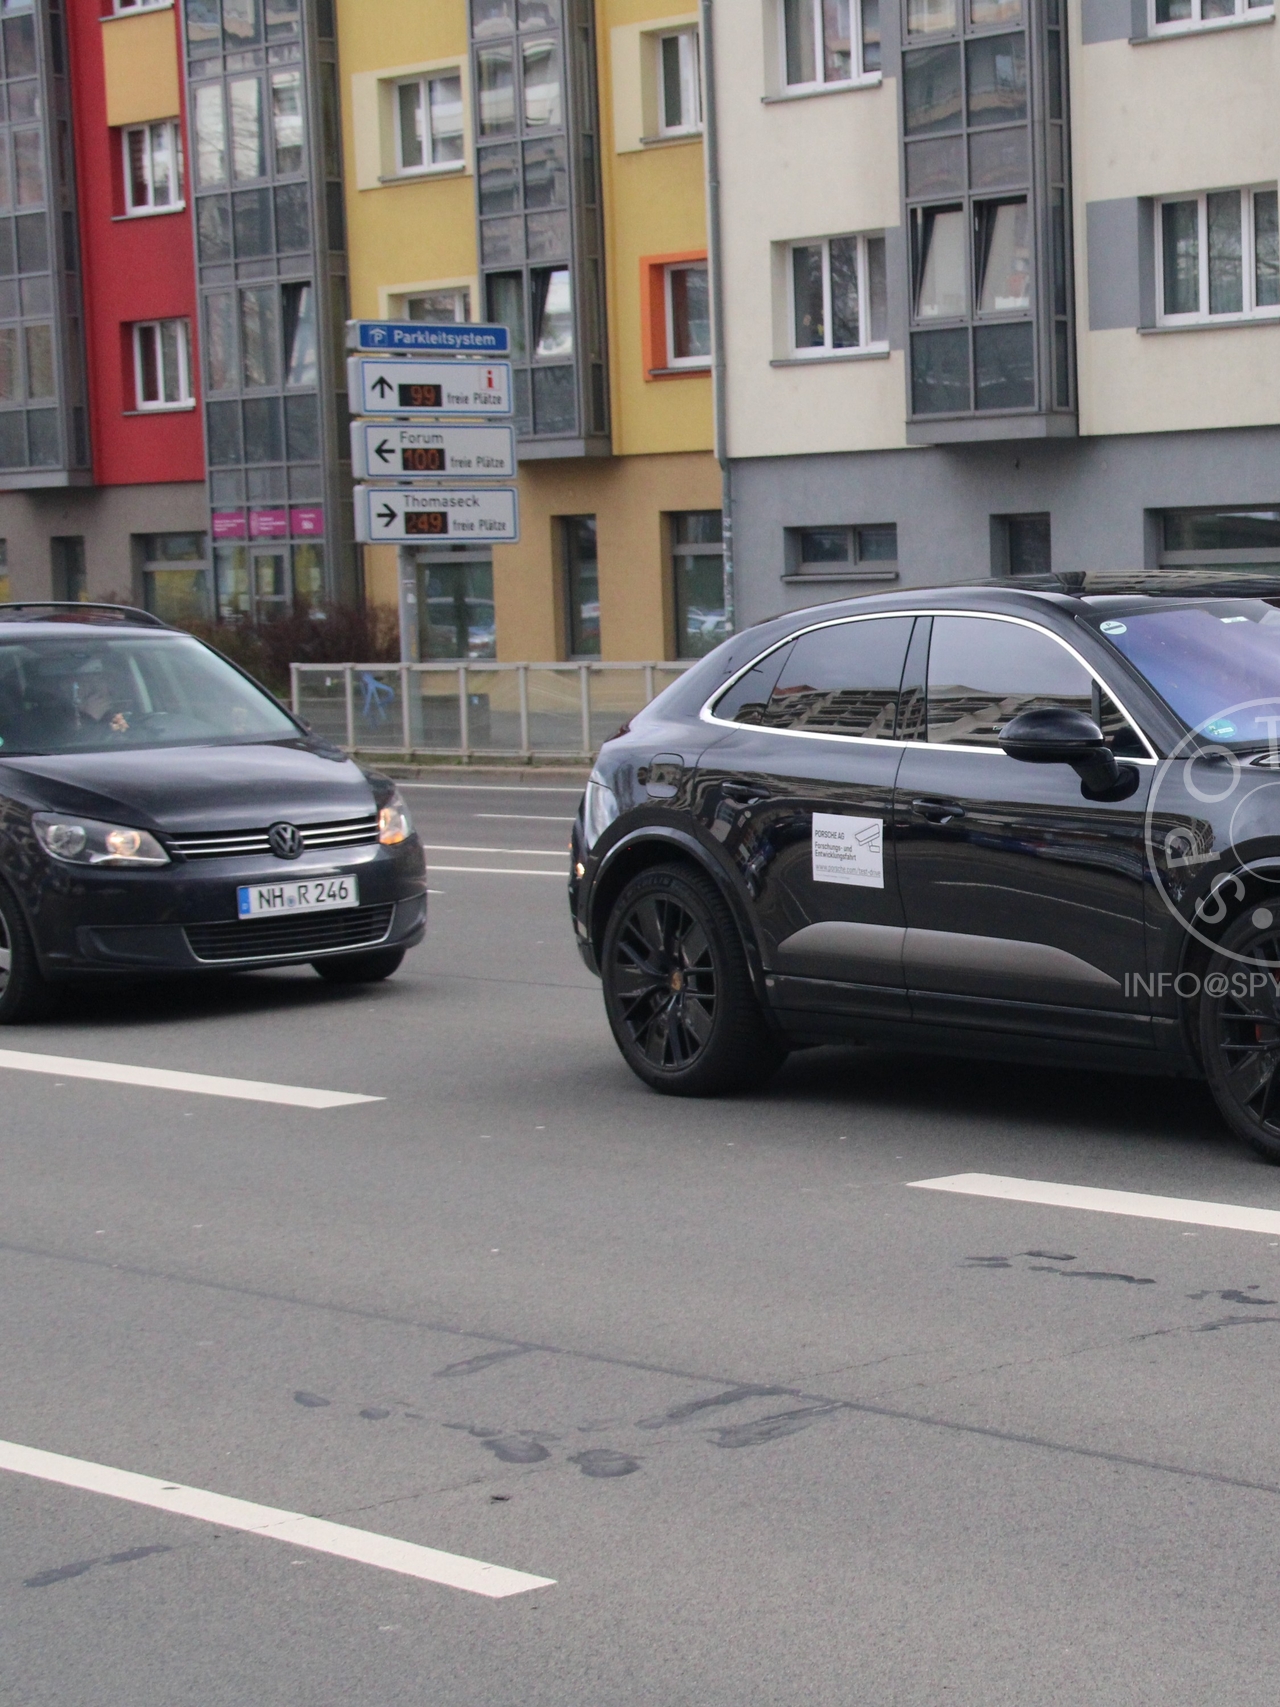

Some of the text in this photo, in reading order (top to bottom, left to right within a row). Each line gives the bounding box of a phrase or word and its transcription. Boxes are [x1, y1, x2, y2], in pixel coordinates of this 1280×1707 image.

[393, 330, 496, 348] Parkleitsystem
[410, 385, 502, 406] 99 freie Plätze
[400, 431, 444, 444] Forum
[403, 448, 505, 470] 100 freie Plätze
[403, 494, 480, 508] Thomaseck
[405, 511, 507, 533] 249 freie Plätze
[815, 829, 845, 840] PORSCHE AG
[815, 841, 842, 852] Forschungs-
[815, 849, 856, 861] Entwicklungsfahrt
[258, 887, 284, 909] NH
[298, 885, 309, 905] R
[315, 881, 349, 902] 246
